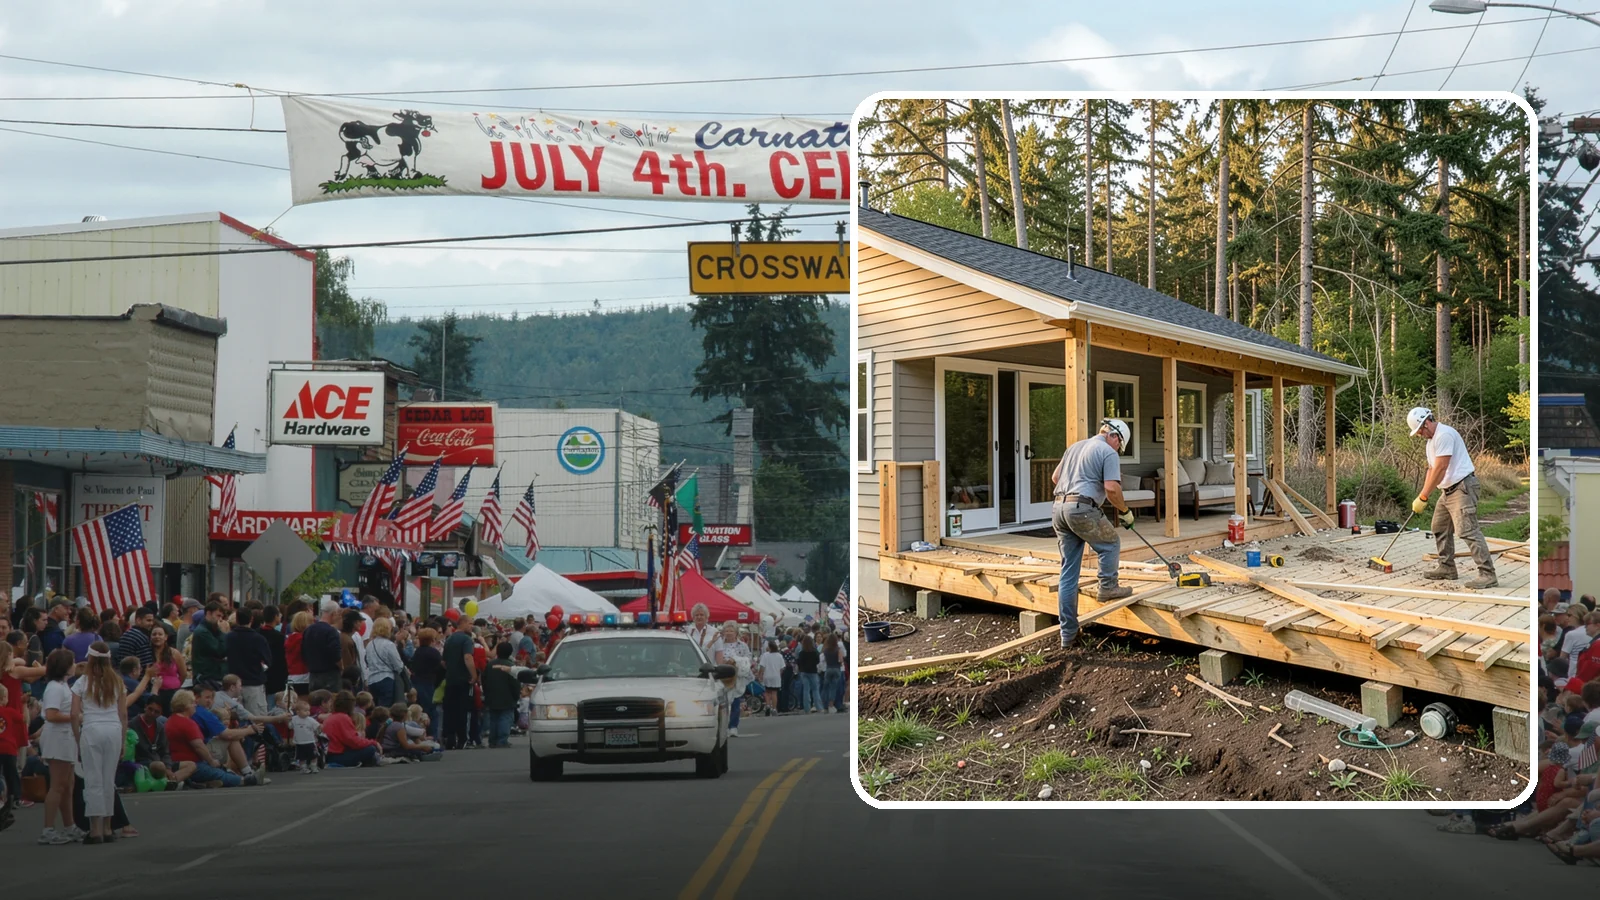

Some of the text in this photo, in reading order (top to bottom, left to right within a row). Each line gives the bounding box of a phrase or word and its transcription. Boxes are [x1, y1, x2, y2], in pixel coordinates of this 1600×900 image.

[481, 141, 605, 192] JULY
[632, 150, 747, 198] 4th.
[697, 254, 850, 280] CROSSWA
[283, 380, 373, 420] ACE
[406, 409, 452, 421] CEDAR
[283, 421, 370, 436] Hardware
[416, 428, 476, 447] Coca-Cola
[96, 485, 124, 494] Vincent
[126, 486, 136, 494] de
[137, 486, 155, 495] Paul
[688, 526, 741, 535] CRNATION
[699, 535, 730, 543] GLASS
